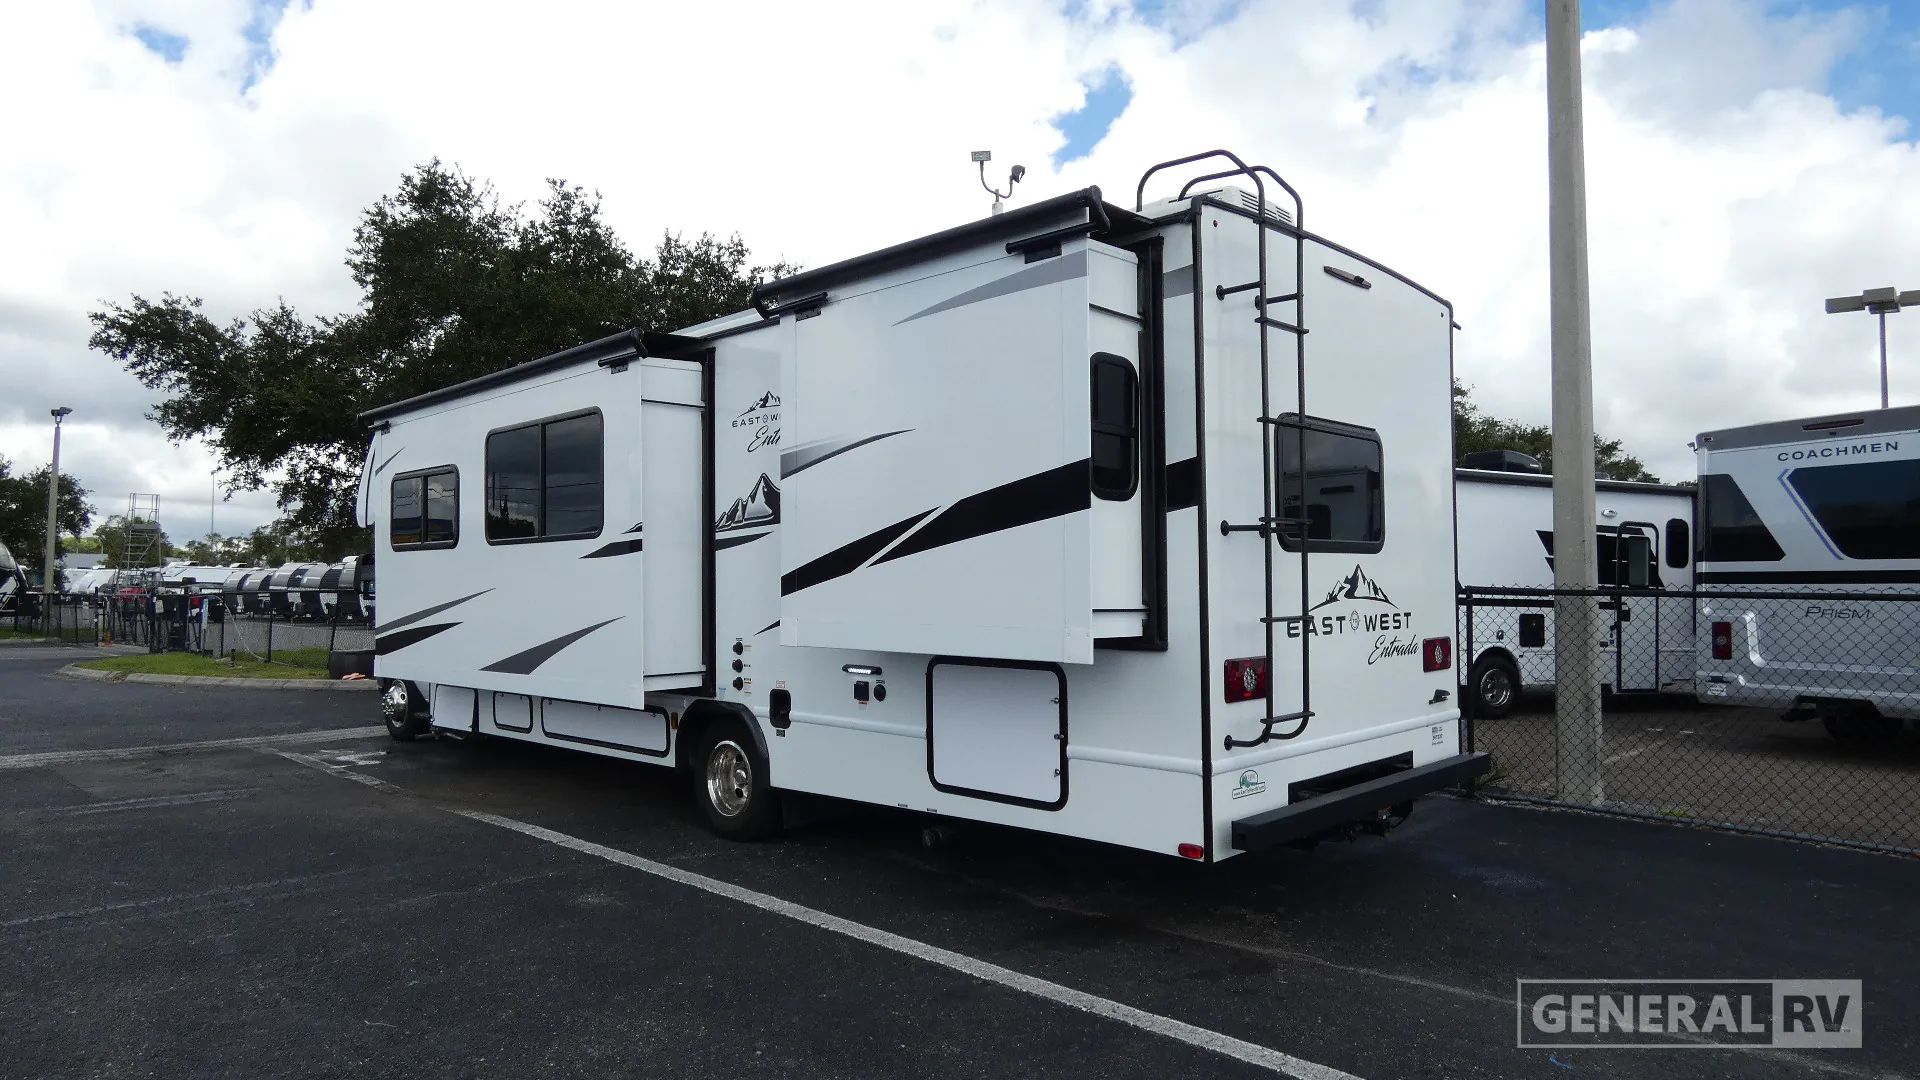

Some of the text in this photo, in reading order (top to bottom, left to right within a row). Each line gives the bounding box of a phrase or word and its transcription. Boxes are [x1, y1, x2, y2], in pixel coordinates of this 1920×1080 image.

[732, 416, 761, 428] EAST
[747, 425, 781, 453] Entr
[1777, 441, 1899, 462] COACHMEN
[1364, 611, 1412, 633] WEST
[1805, 606, 1870, 619] PRISM
[1367, 633, 1419, 666] Entrada
